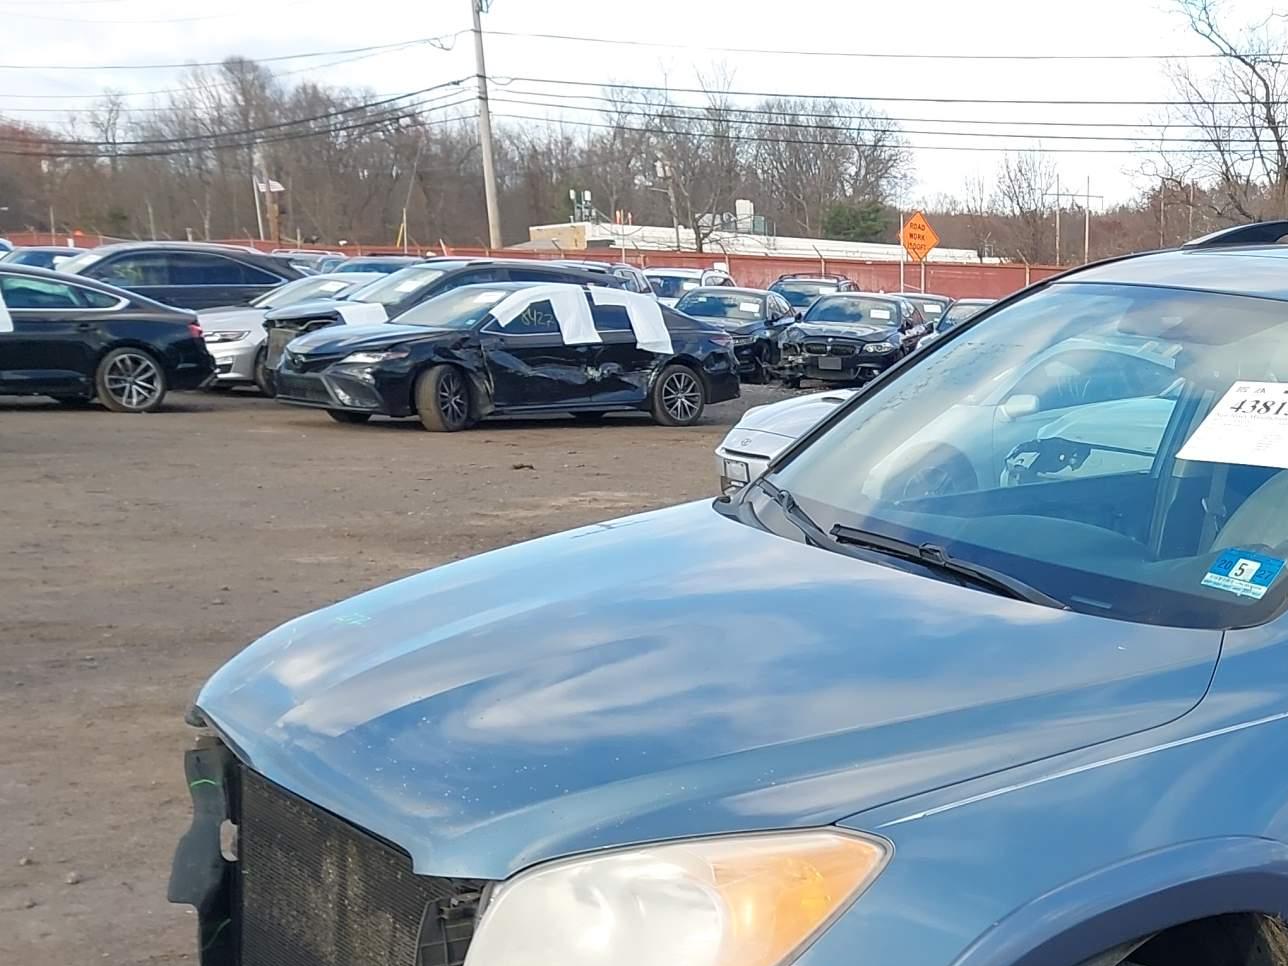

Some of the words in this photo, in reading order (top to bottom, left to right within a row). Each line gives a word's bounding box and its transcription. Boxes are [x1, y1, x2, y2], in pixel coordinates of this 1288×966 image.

[909, 222, 926, 231] ROAD
[909, 233, 926, 241] WORK
[1217, 559, 1233, 570] 20
[1234, 562, 1249, 577] 5
